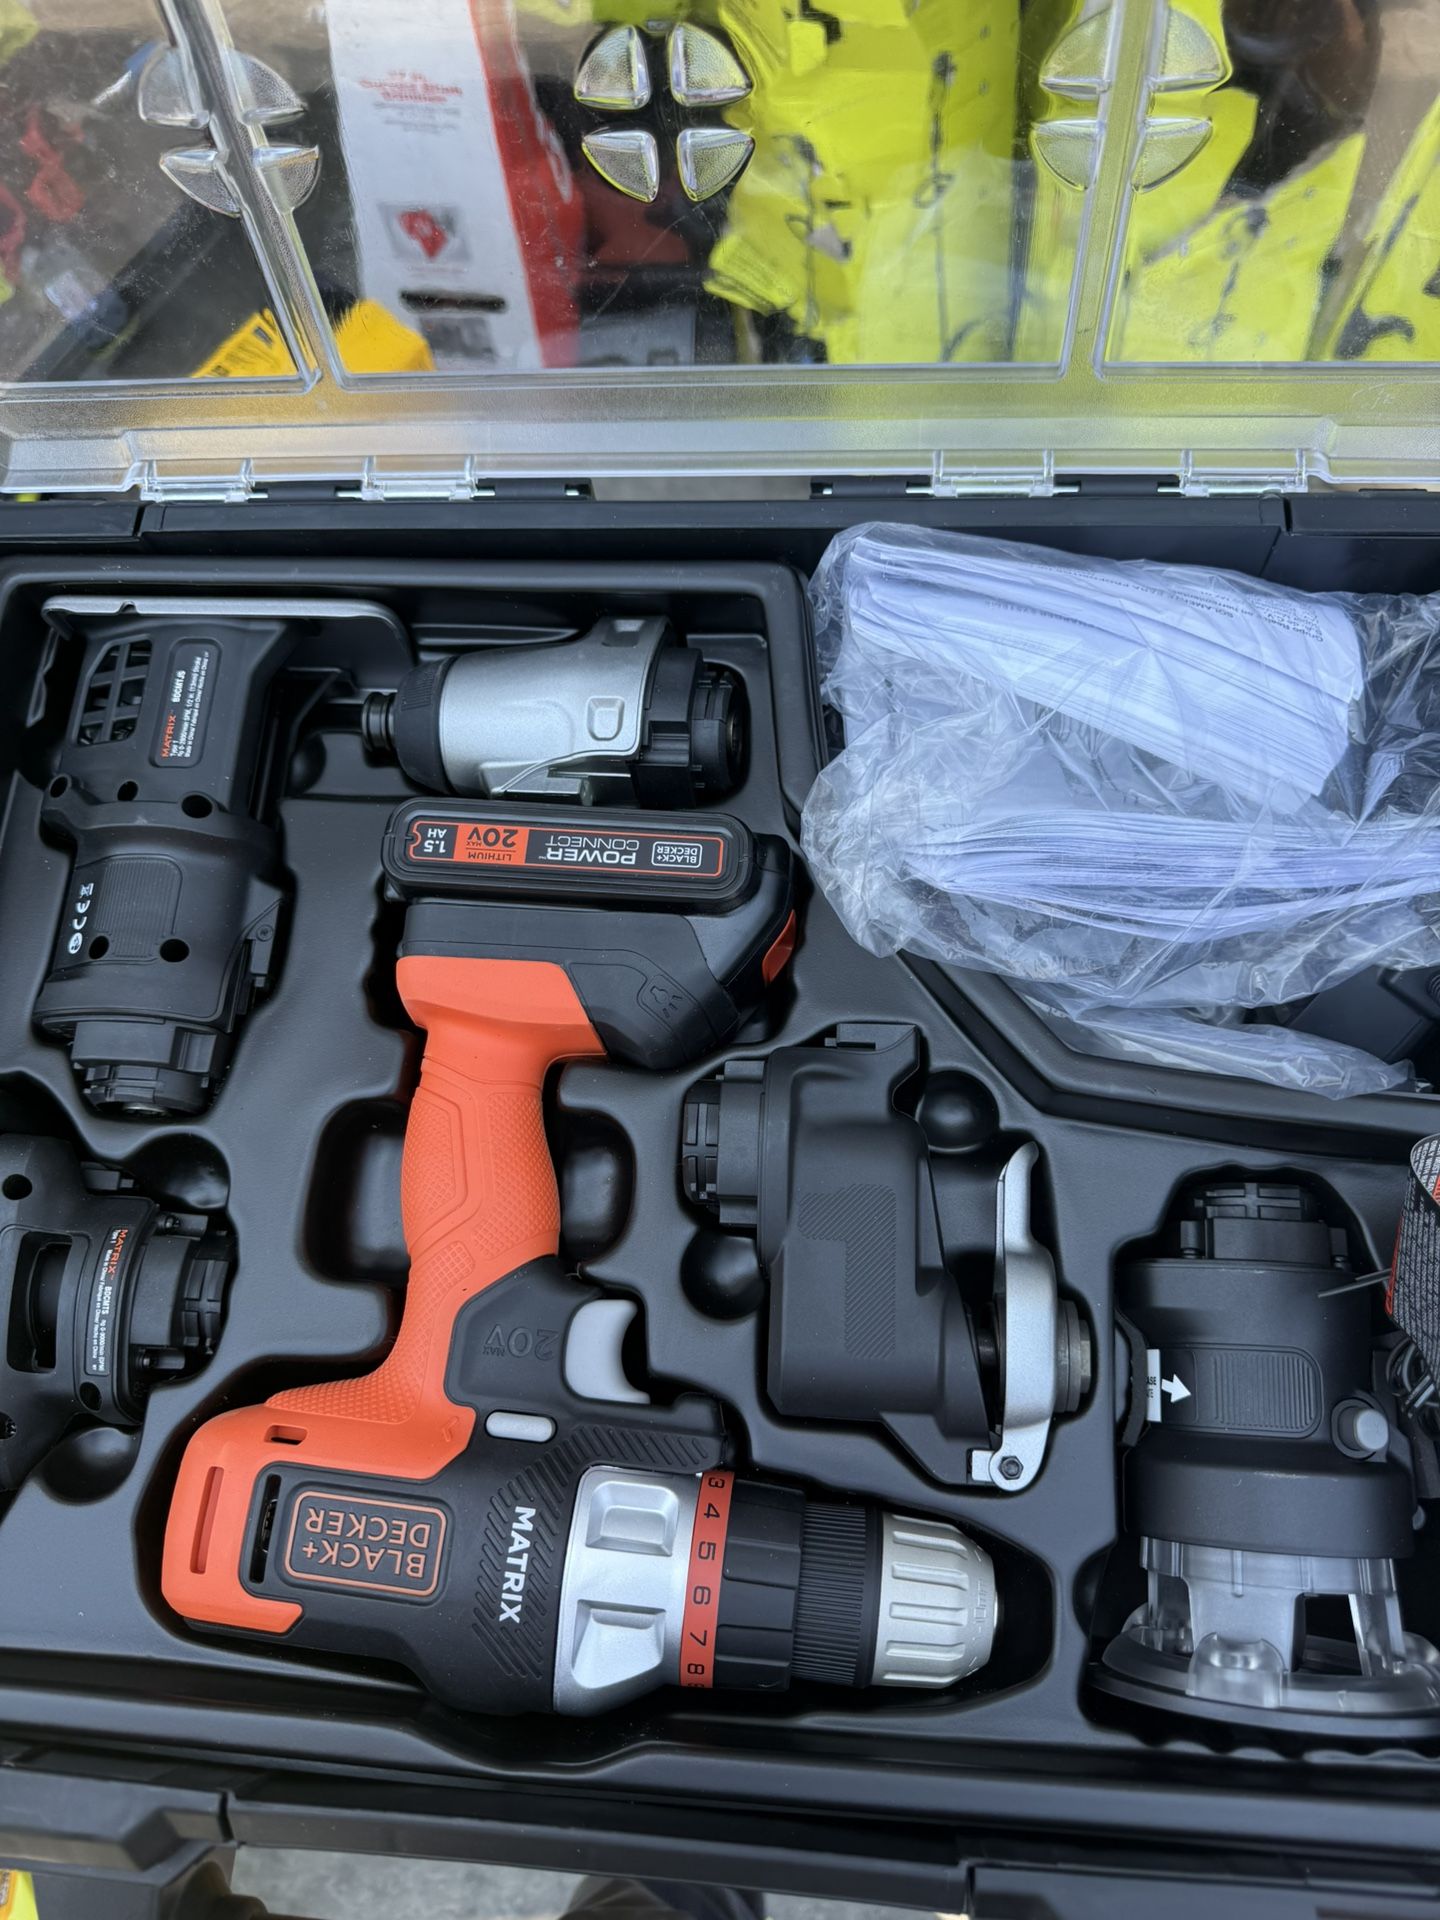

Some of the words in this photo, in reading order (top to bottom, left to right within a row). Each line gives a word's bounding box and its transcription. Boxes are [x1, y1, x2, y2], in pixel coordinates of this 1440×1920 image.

[427, 828, 448, 839] AH
[467, 827, 519, 849] 20V
[423, 840, 446, 853] 1.5
[545, 835, 640, 851] CONNECT
[656, 845, 698, 856] DECKER
[467, 851, 512, 862] LITHIUM
[656, 853, 697, 864] BLACK+
[102, 1286, 113, 1315] BDCMTS
[485, 1324, 560, 1361] 20V
[707, 1476, 726, 1489] 3
[703, 1502, 721, 1519] 4
[304, 1507, 432, 1549] DECKER
[302, 1539, 427, 1579] BLACK+
[697, 1540, 717, 1561] 5
[498, 1505, 537, 1624] MATRIX
[692, 1585, 712, 1606] 6
[689, 1629, 708, 1647] 7
[687, 1662, 705, 1676] 8
